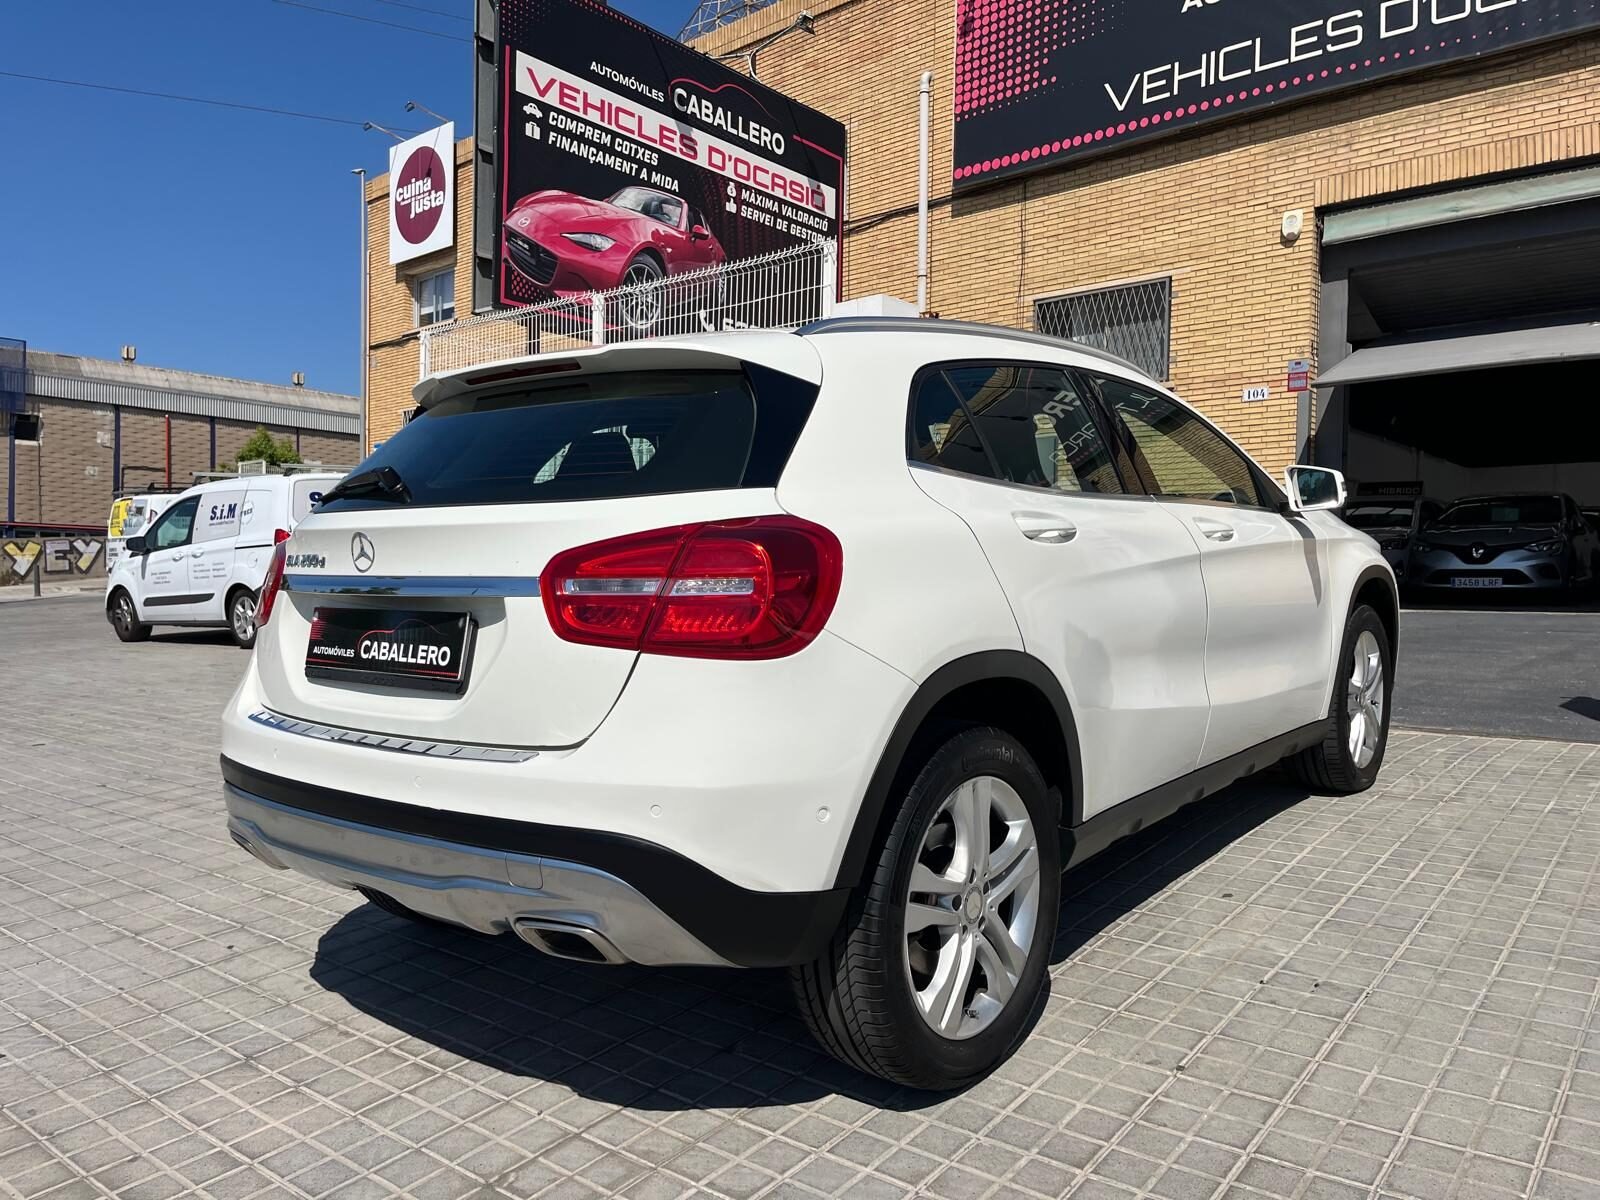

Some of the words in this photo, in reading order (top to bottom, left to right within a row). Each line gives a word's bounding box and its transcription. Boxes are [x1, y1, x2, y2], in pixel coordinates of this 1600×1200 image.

[1104, 10, 1362, 112] VEHICLES
[590, 61, 665, 102] AUTOMÓVILES
[673, 87, 785, 155] CABALLERO
[526, 66, 698, 161] VEHICLES
[708, 145, 826, 212] D'OCASIÓ
[548, 111, 611, 147] COMPREM
[614, 138, 659, 166] COTXES
[548, 131, 638, 176] FINANÇAMENT
[640, 167, 648, 181] A
[651, 171, 680, 193] MIDA
[396, 178, 432, 202] cuina
[410, 190, 444, 219] justa
[741, 188, 779, 214] MÀXIMA
[781, 201, 829, 232] VALORACIÓ
[740, 206, 774, 228] SERVEI
[776, 218, 788, 233] DE
[790, 223, 832, 244] GESTORI
[1247, 388, 1265, 400] 104
[209, 503, 238, 521] S.i.M
[313, 646, 355, 658] AUTOMÓVILES
[360, 640, 451, 667] CABALLERO
